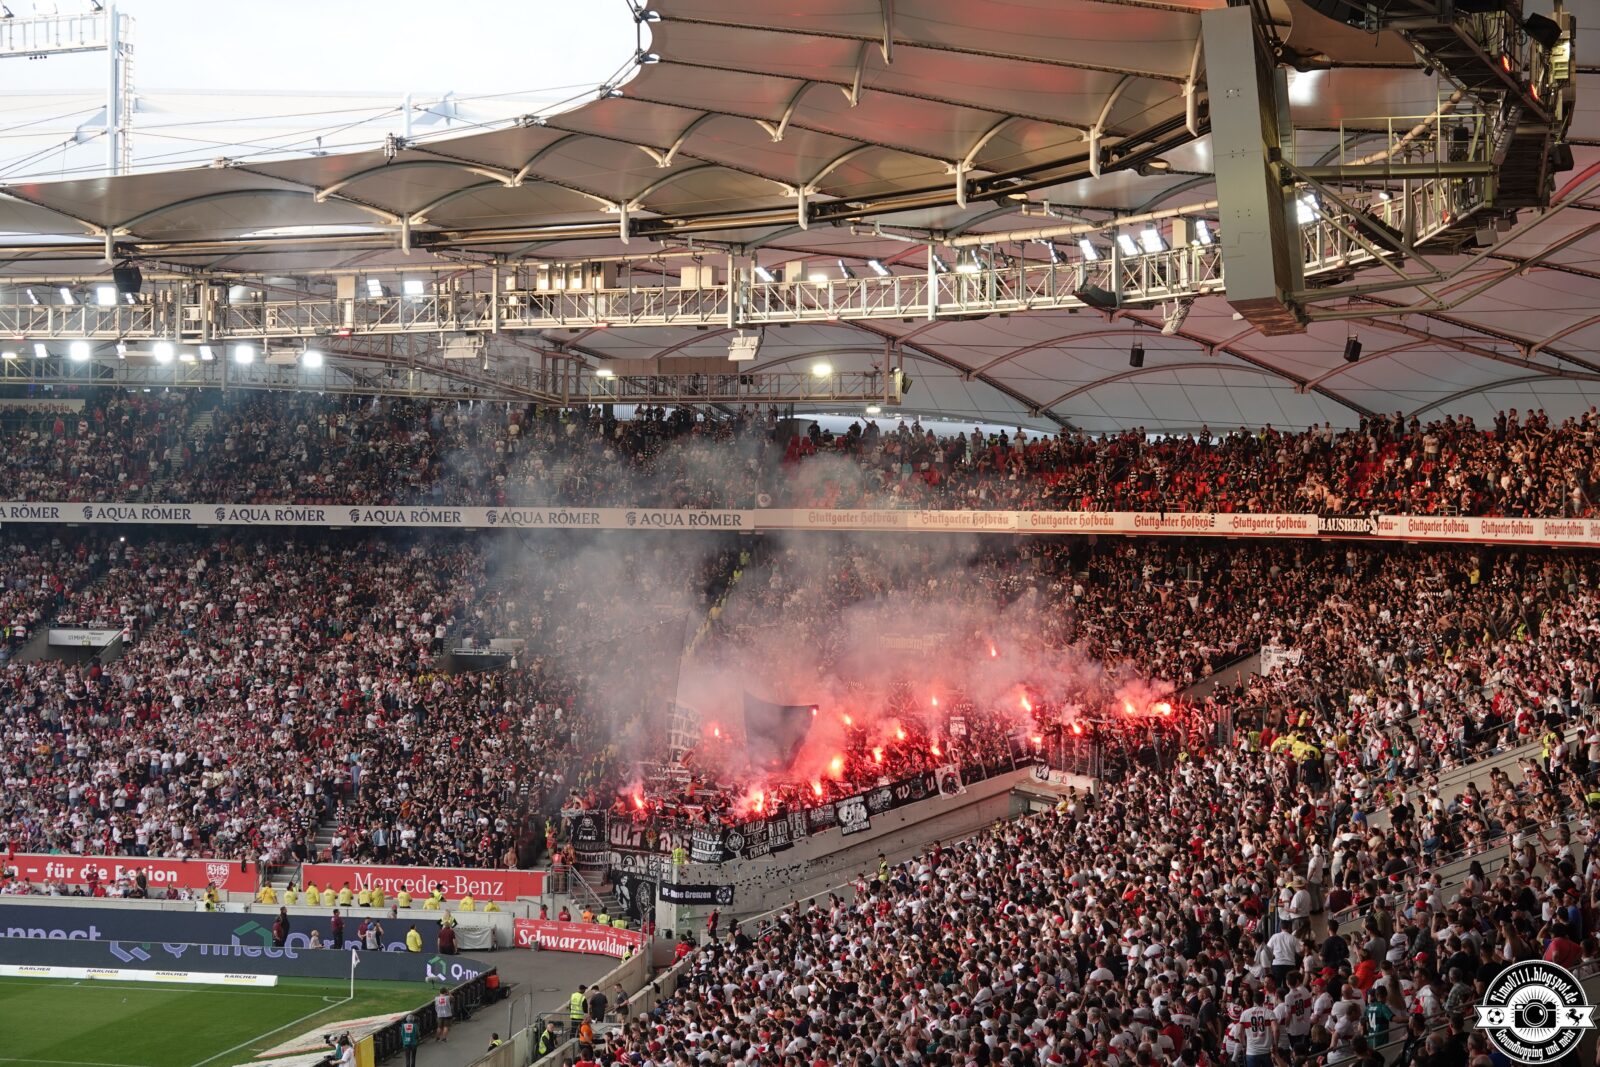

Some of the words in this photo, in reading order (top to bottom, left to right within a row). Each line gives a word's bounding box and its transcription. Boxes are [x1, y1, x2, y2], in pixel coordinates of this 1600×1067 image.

[10, 504, 59, 519] RÖMER
[96, 507, 138, 521] AQUA
[142, 505, 191, 520] RÖMER
[229, 508, 270, 523] AQUA
[275, 505, 326, 522] RÖMER
[363, 509, 406, 524] AQUA
[410, 507, 461, 523] RÖMER
[500, 511, 544, 526] AQUA
[548, 509, 600, 525] RÖMER
[640, 512, 684, 527] AQUA
[688, 510, 742, 526] RÖMER
[921, 513, 969, 526] Stuttgarter
[1031, 513, 1077, 527] Stuttgarter
[1079, 514, 1114, 528] Hofbräu
[1232, 516, 1274, 530] Stuttgarter
[1276, 516, 1307, 530] Hofbräu
[1408, 519, 1442, 534] Stuttgarter
[1443, 519, 1469, 535] Hofbräu
[1481, 520, 1510, 536] Stuttgarter
[1511, 521, 1534, 536] Hofbräu
[46, 861, 75, 879] für
[353, 872, 504, 896] Mercedes-Benz
